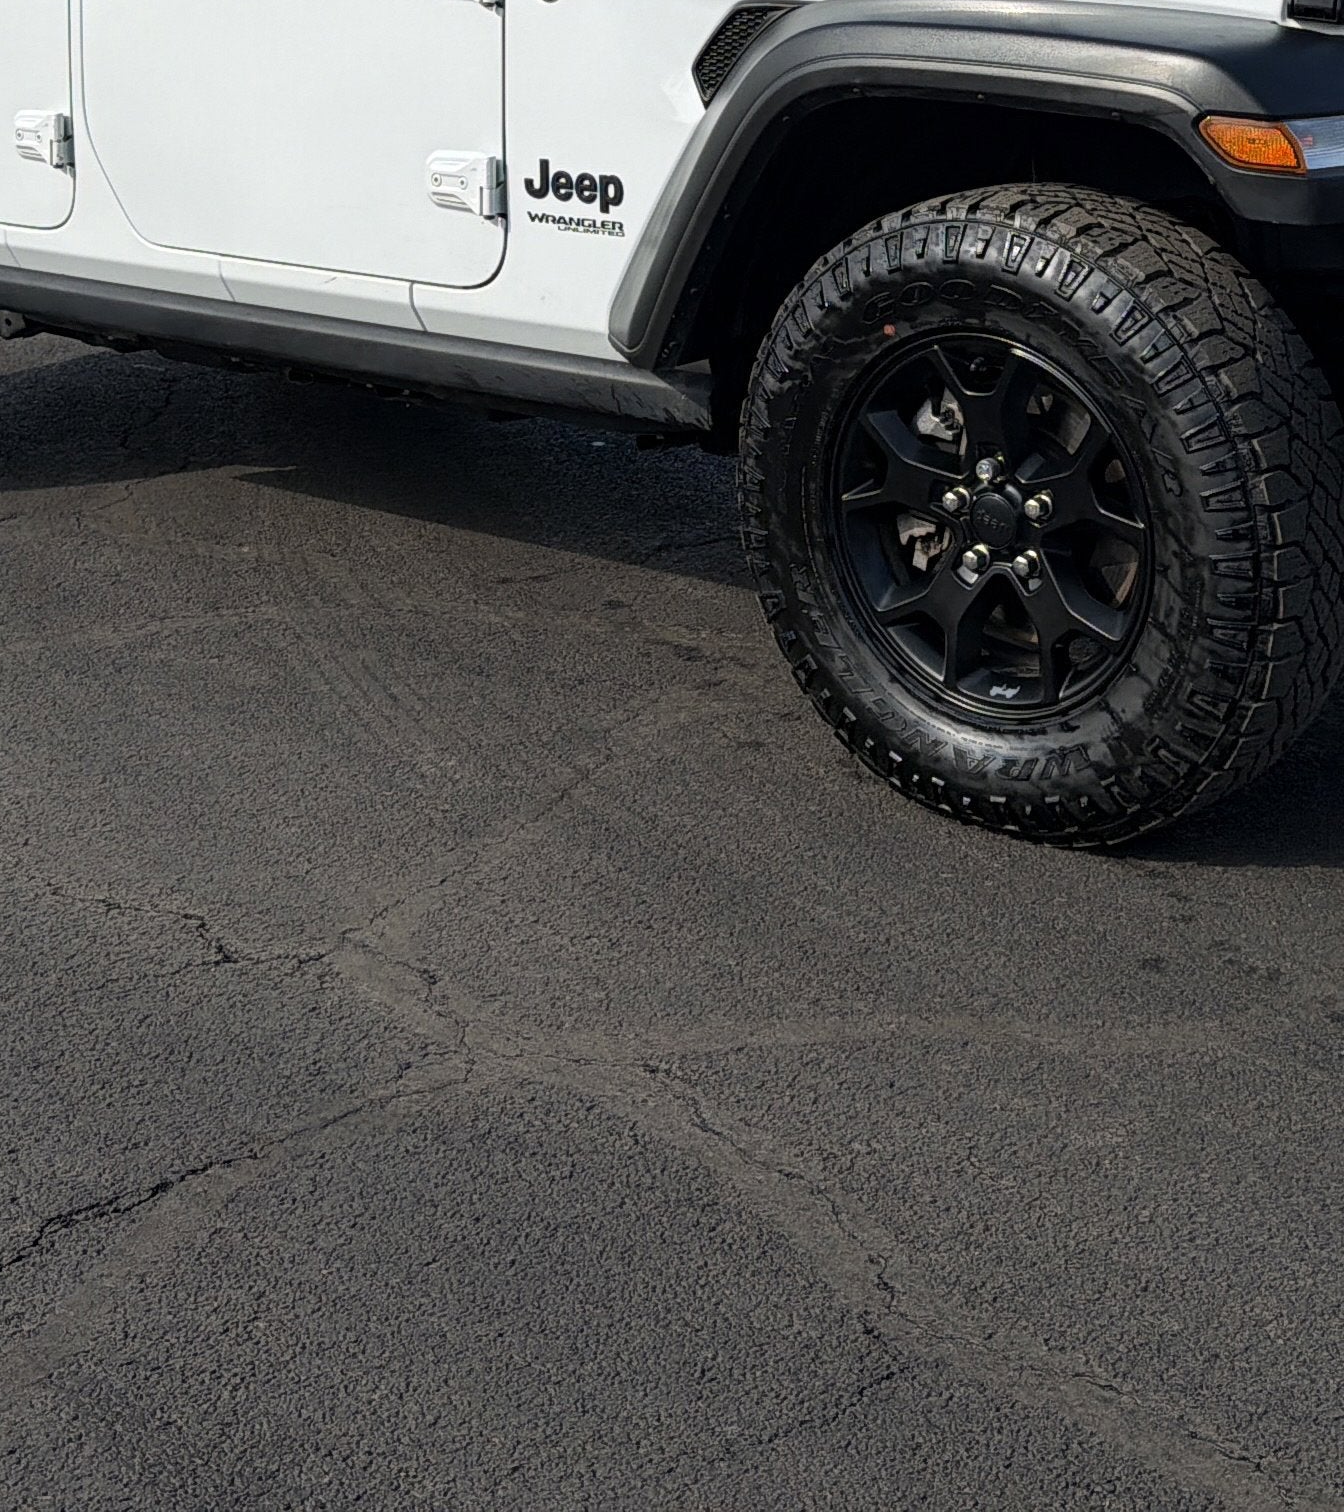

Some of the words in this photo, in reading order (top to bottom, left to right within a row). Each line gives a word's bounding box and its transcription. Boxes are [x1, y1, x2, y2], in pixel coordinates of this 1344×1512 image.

[524, 158, 624, 214] Jeep
[527, 210, 624, 232] WRANGLER
[557, 225, 625, 238] UNLIMITED
